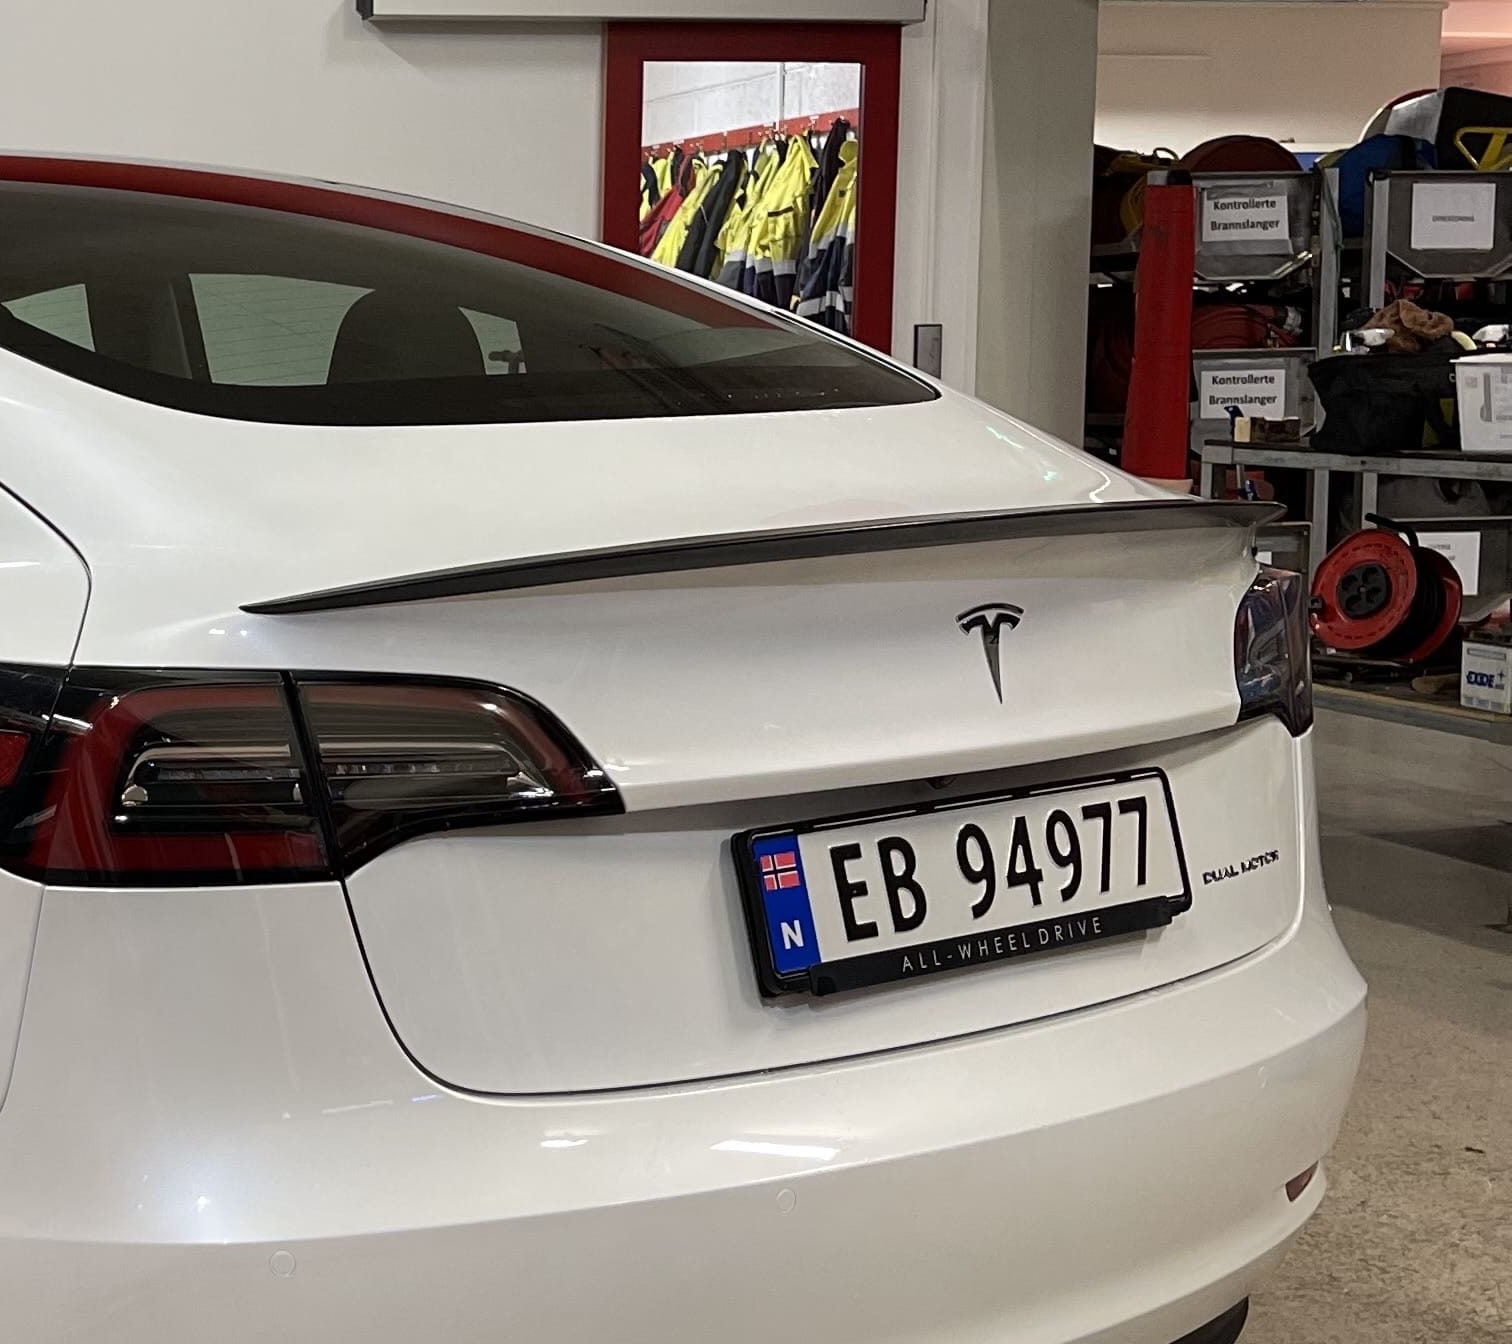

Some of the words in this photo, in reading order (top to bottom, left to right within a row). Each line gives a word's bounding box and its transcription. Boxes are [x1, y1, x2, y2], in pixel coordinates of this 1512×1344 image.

[1213, 198, 1277, 211] Kontrollerte
[1210, 219, 1281, 232] Brannslanger
[1211, 374, 1276, 386] Kontrollerte
[1209, 395, 1278, 407] Brannslanger
[829, 836, 928, 943] EB
[956, 795, 1148, 920] 94977
[1202, 864, 1240, 886] DUAL
[780, 919, 805, 950] N
